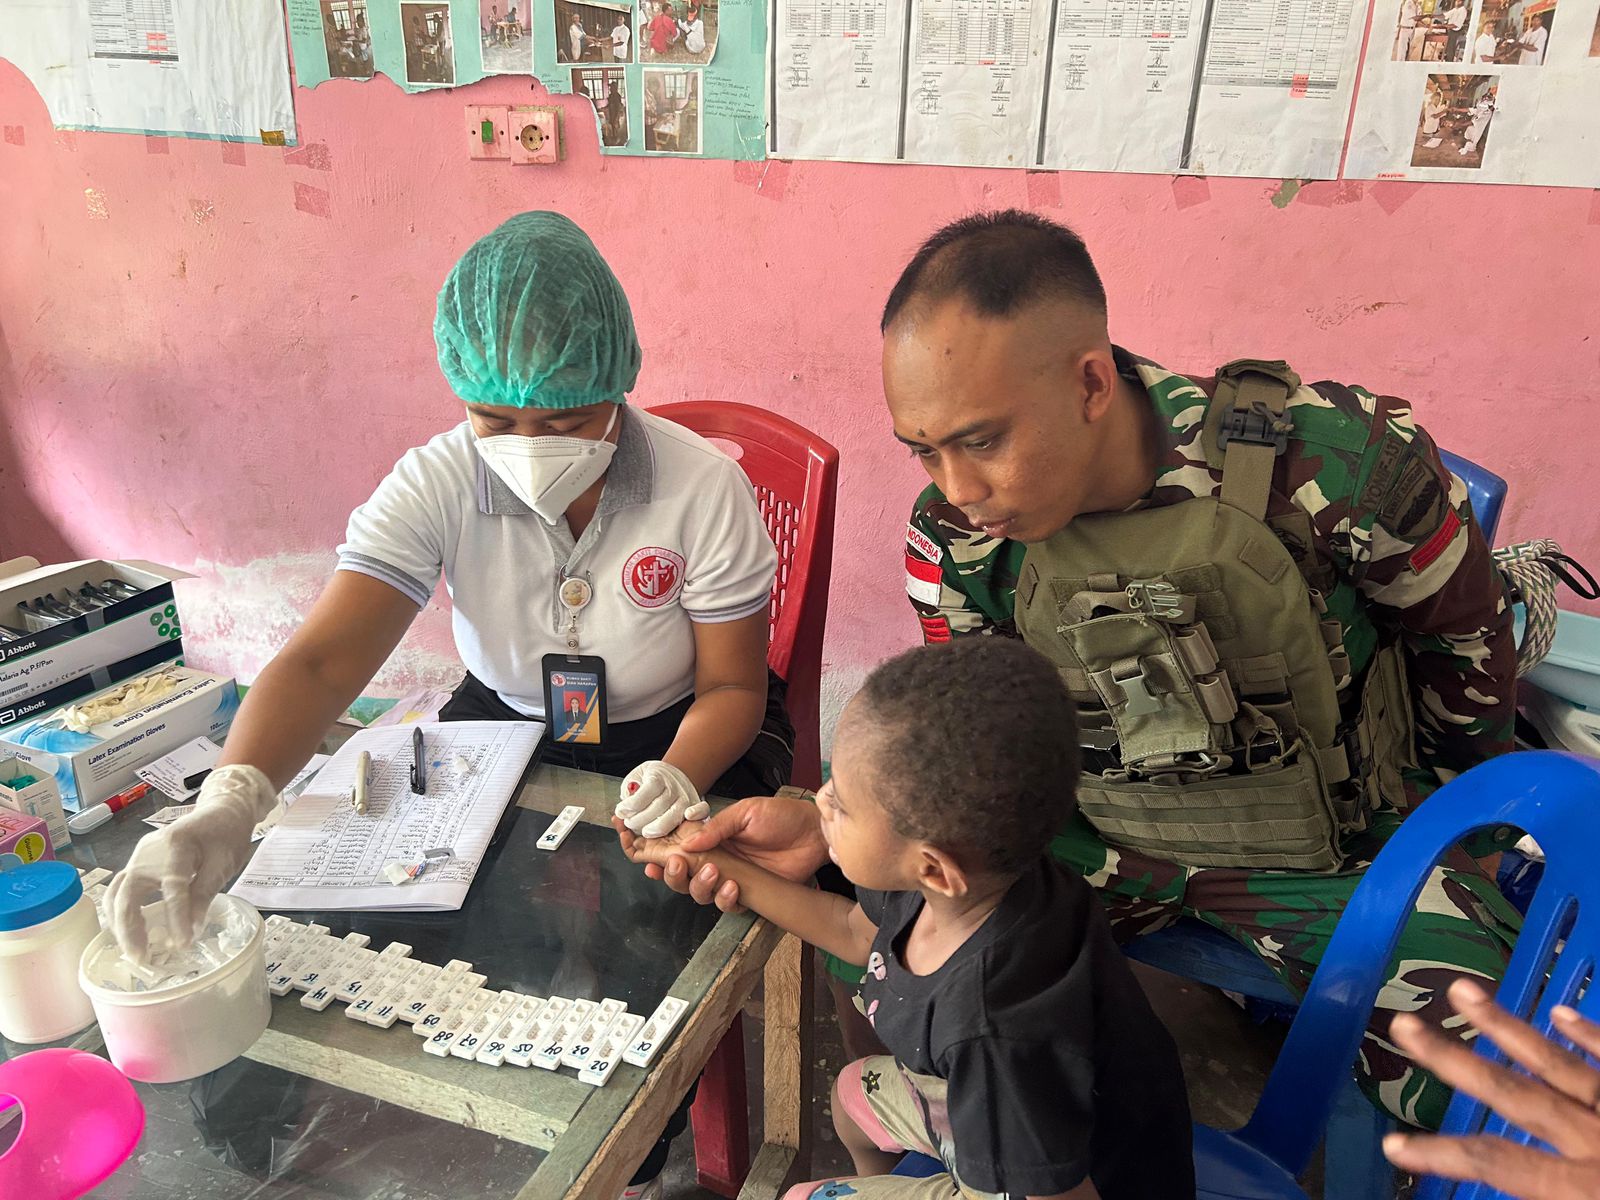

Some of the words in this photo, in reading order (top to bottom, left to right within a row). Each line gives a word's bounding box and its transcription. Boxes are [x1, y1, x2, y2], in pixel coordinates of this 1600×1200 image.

[7, 641, 37, 656] Abbott
[20, 668, 30, 676] Ag
[193, 678, 216, 690] Latex
[143, 689, 194, 713] Examination
[17, 700, 47, 716] Abbott
[113, 712, 144, 728] Gloves
[88, 752, 106, 765] Latex
[107, 733, 145, 756] Examination
[145, 723, 166, 737] Gloves
[302, 973, 319, 982] 15
[312, 986, 328, 1000] 14
[349, 981, 362, 993] 13
[356, 1000, 373, 1010] 12
[411, 1002, 426, 1012] 10
[377, 1006, 393, 1017] 11
[423, 1014, 440, 1026] 09
[433, 1031, 454, 1042] 08
[459, 1034, 478, 1047] 07
[489, 1042, 505, 1052] 06
[512, 1043, 534, 1053] 05
[544, 1041, 563, 1056] 04
[571, 1045, 590, 1055] 03
[636, 1041, 652, 1052] 01
[590, 1060, 609, 1072] 02
